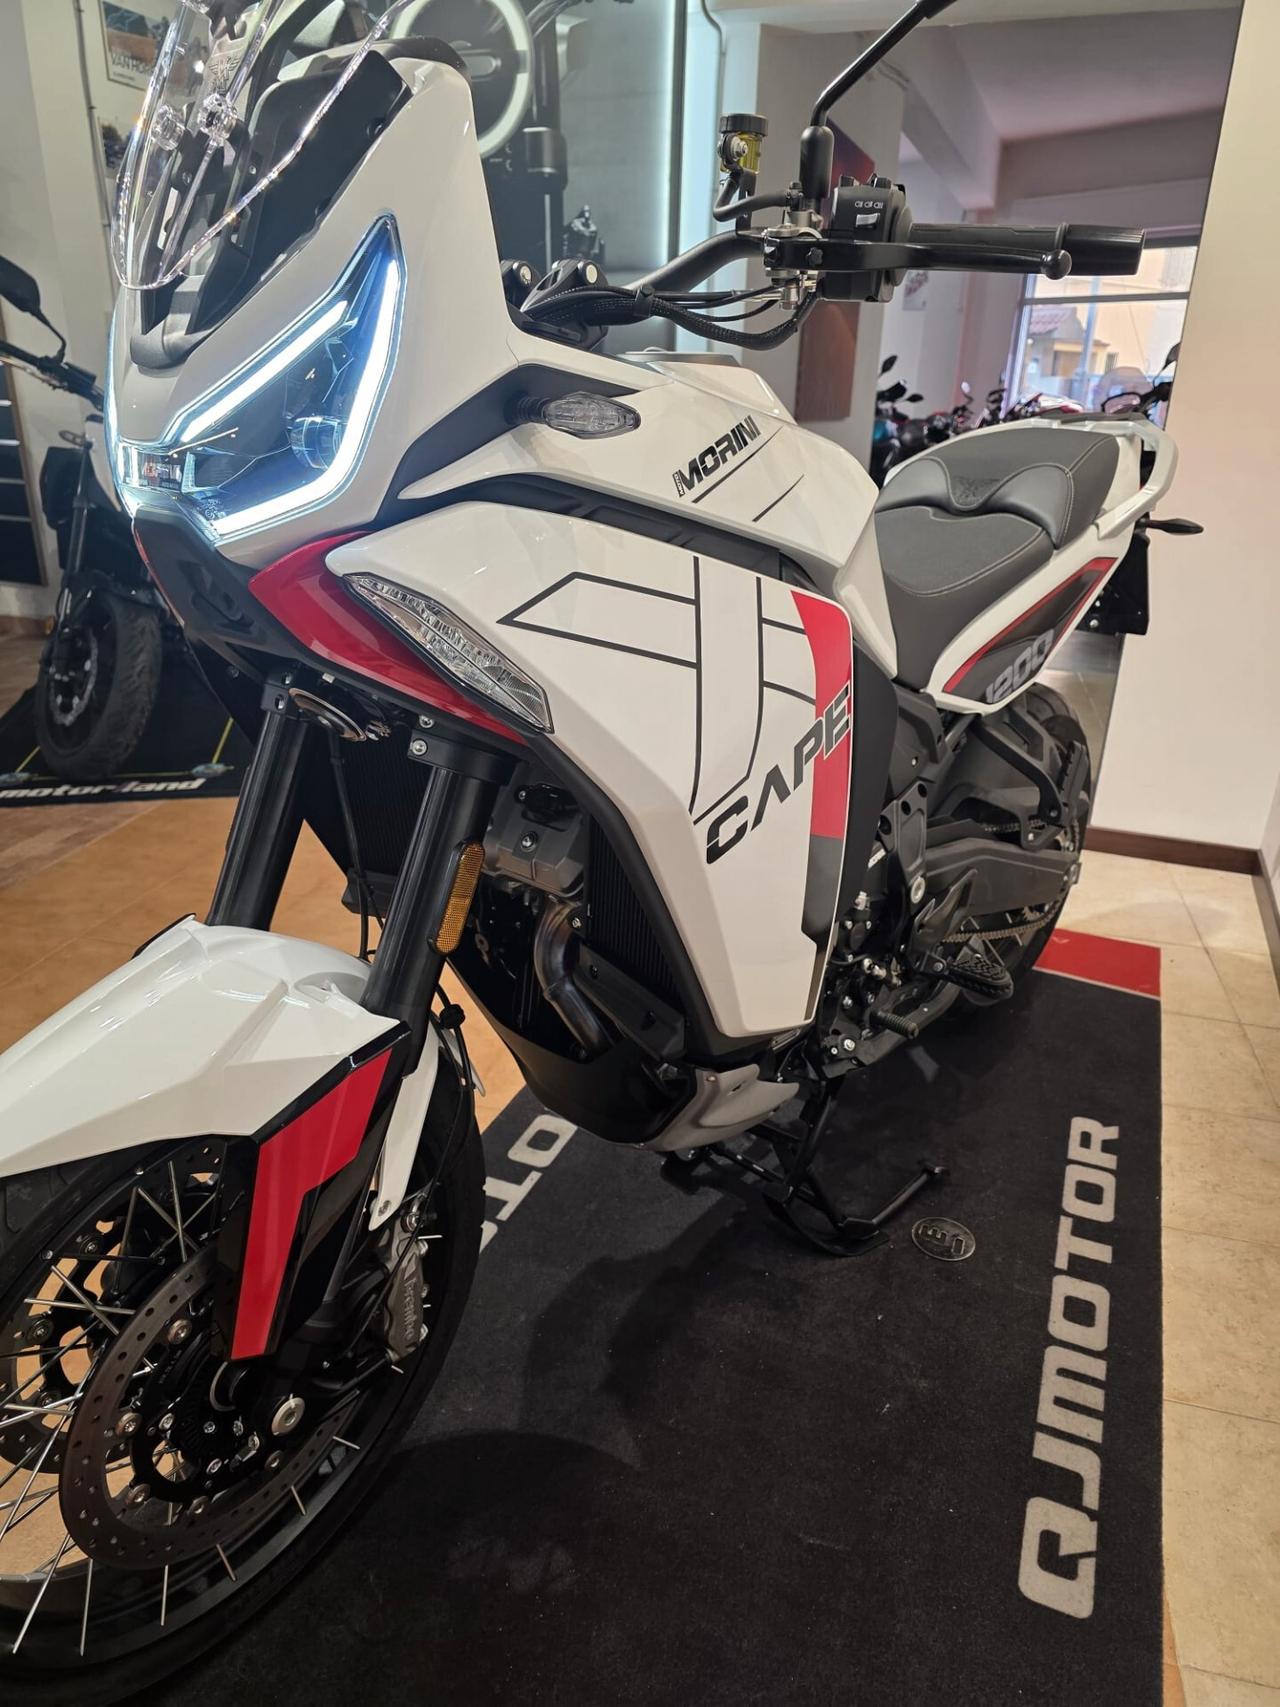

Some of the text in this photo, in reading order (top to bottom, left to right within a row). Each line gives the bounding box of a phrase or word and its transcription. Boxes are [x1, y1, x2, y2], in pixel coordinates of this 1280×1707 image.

[678, 414, 761, 491] MORINI
[985, 628, 1054, 704] 1200
[706, 680, 851, 865] CAPE
[1018, 1116, 1119, 1619] QJMOTOR
